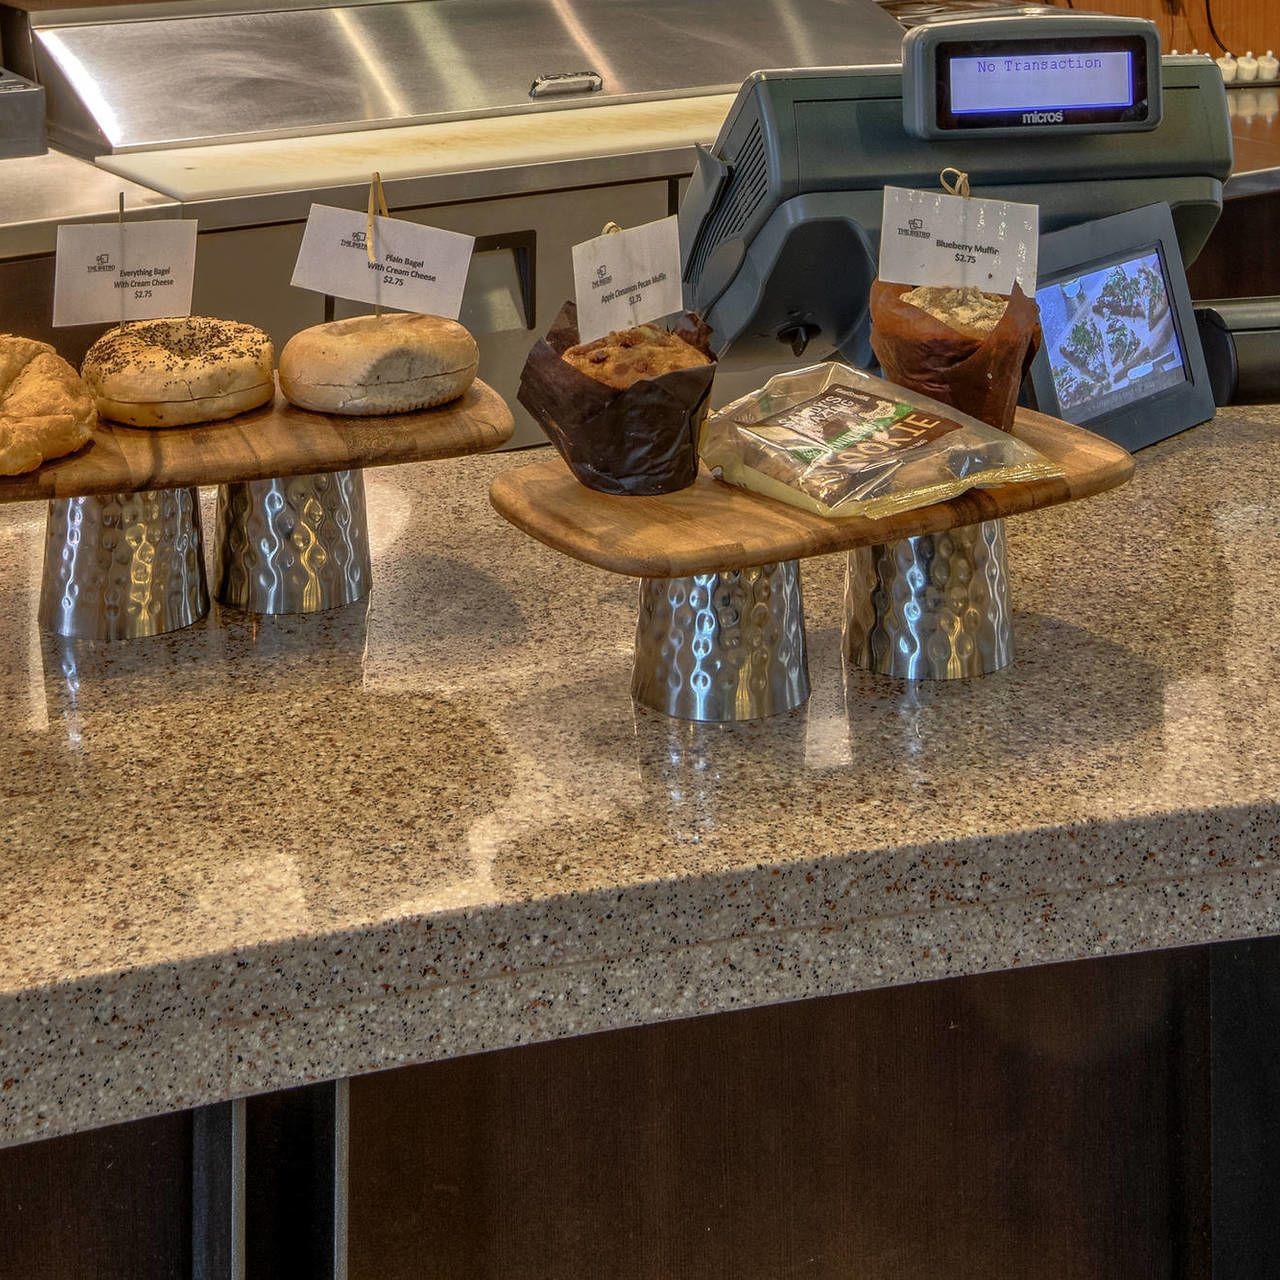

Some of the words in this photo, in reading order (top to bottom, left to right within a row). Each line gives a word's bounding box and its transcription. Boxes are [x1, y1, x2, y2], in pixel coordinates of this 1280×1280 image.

[978, 60, 996, 73] No
[1003, 57, 1102, 73] Transaction
[1023, 110, 1063, 125] micros
[936, 239, 973, 253] Blueberry
[974, 244, 1000, 255] Muffin
[385, 254, 403, 264] Plain
[404, 257, 424, 269] Bagel
[954, 253, 977, 264] $2.75
[119, 268, 153, 278] Everything
[153, 266, 171, 277] Bagel
[368, 262, 385, 272] With
[385, 266, 410, 277] Cream
[411, 270, 436, 282] Cheese
[114, 280, 129, 288] With
[130, 279, 151, 288] Cream
[151, 278, 174, 287] Cheese
[383, 275, 404, 286] $2.75
[134, 290, 152, 299] $2.75
